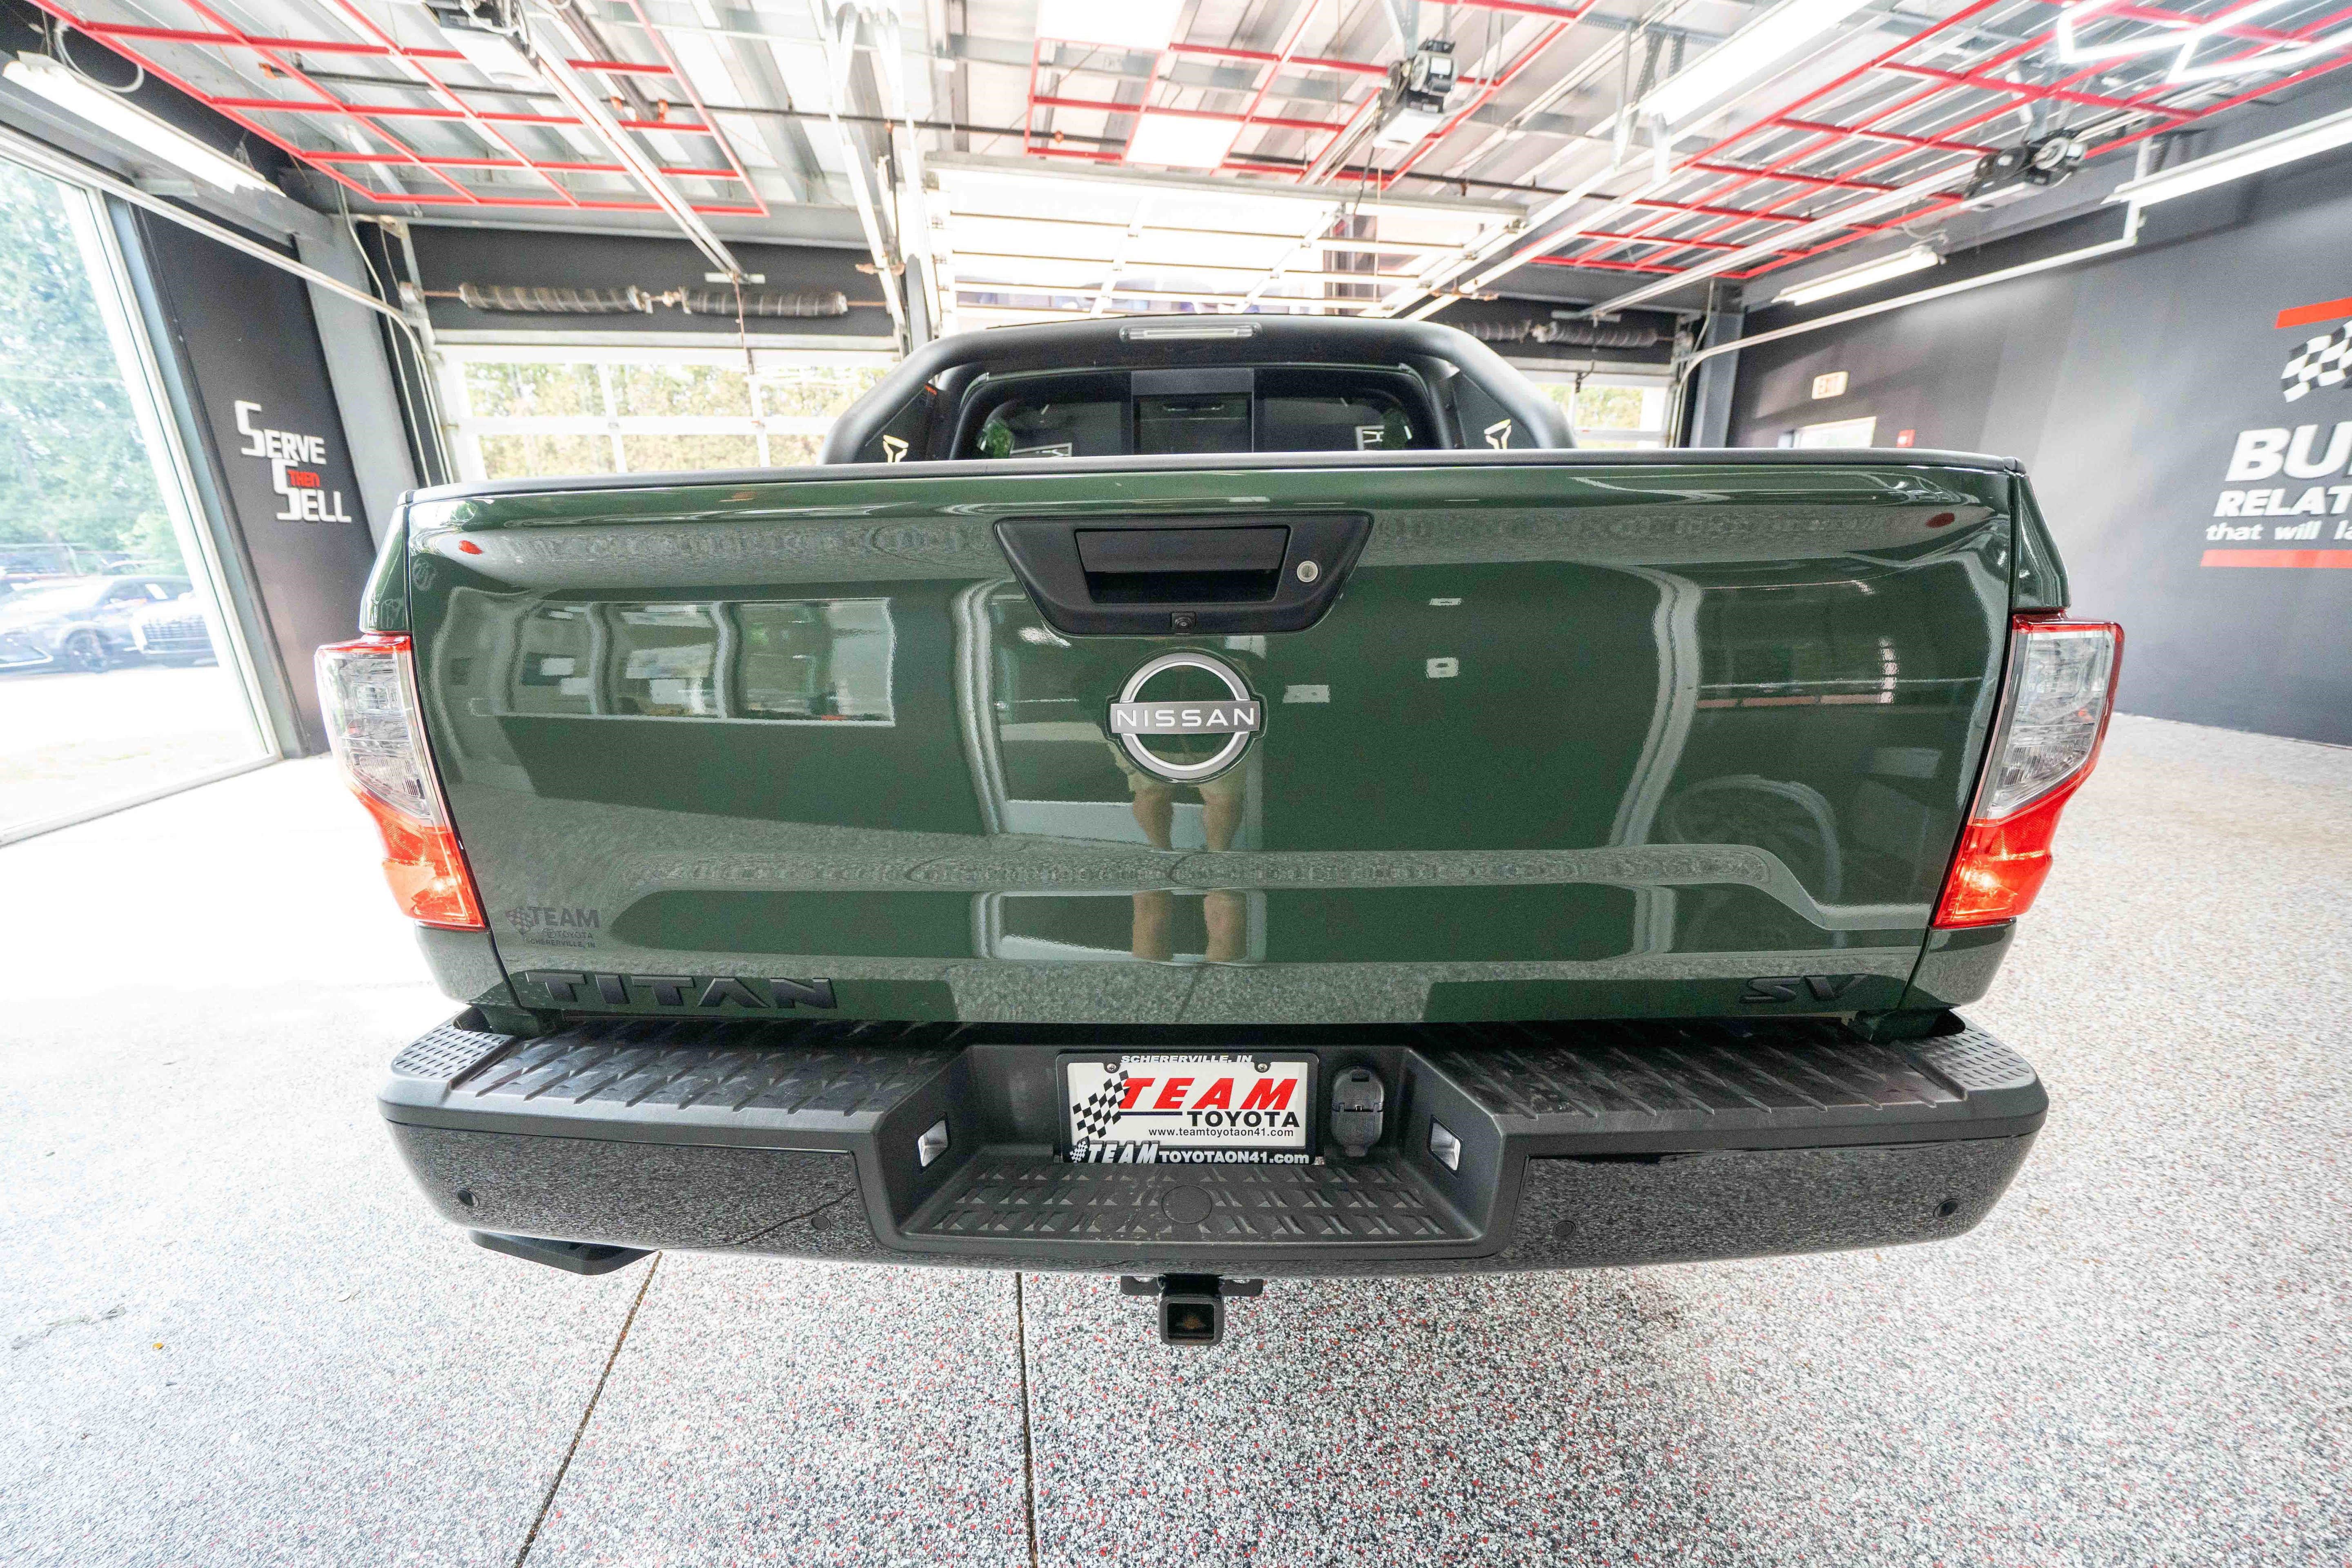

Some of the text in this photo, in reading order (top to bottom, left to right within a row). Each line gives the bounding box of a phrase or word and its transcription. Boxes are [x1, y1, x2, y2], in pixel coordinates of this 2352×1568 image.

[235, 400, 327, 465] SERVE
[2225, 421, 2352, 481] BU
[271, 458, 352, 523] SELL
[2205, 522, 2263, 540] that
[2274, 521, 2322, 540] will
[1116, 708, 1254, 727] NISSAN
[528, 906, 600, 928] TEAM
[525, 971, 838, 1010] TITAN
[1738, 973, 1869, 1003] SV
[1119, 1078, 1298, 1110] TEAM
[1187, 1111, 1300, 1127] TOYOTA
[1149, 1127, 1294, 1138] www.teamtoyotaon41.com
[1088, 1144, 1309, 1163] TEAM TOYOTAON41.com
